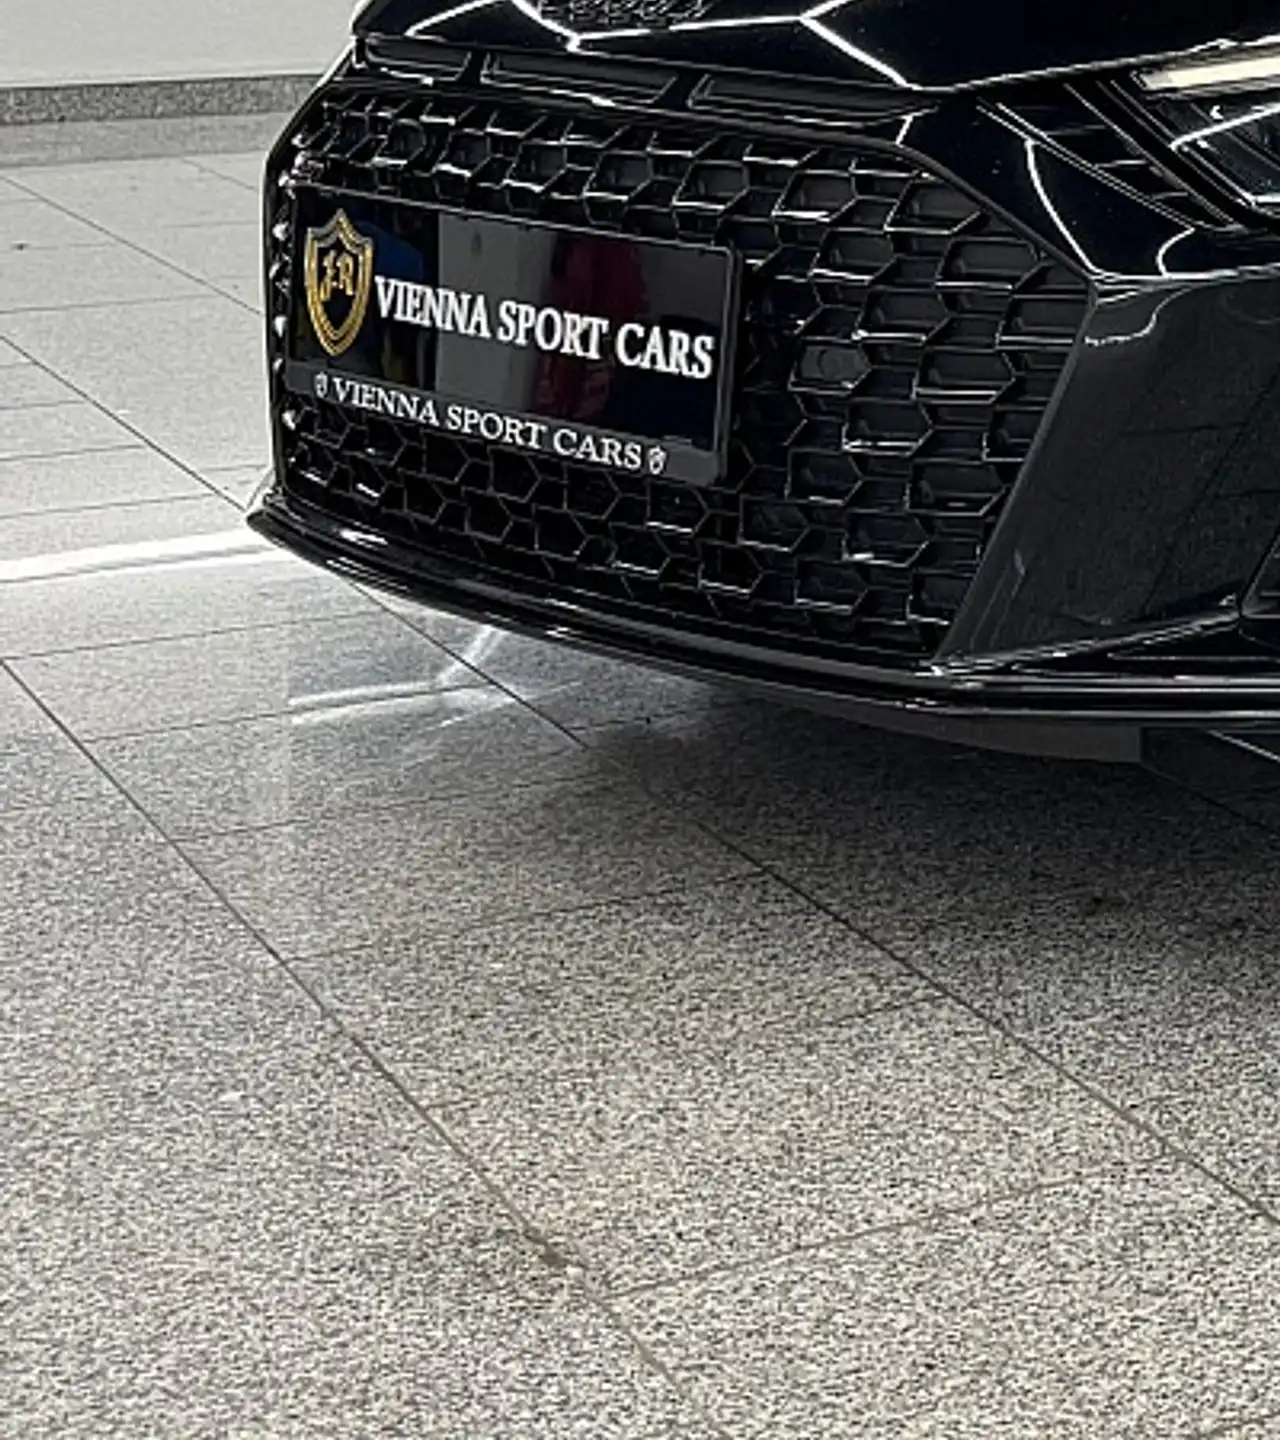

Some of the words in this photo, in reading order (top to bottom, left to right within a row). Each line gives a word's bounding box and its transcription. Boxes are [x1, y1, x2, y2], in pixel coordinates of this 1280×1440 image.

[374, 276, 490, 341] VIENNA
[498, 302, 612, 360] SPORT
[615, 321, 716, 380] CARS
[332, 377, 440, 427] VIENNA
[446, 405, 548, 450] SPORT
[552, 427, 645, 474] CARS
